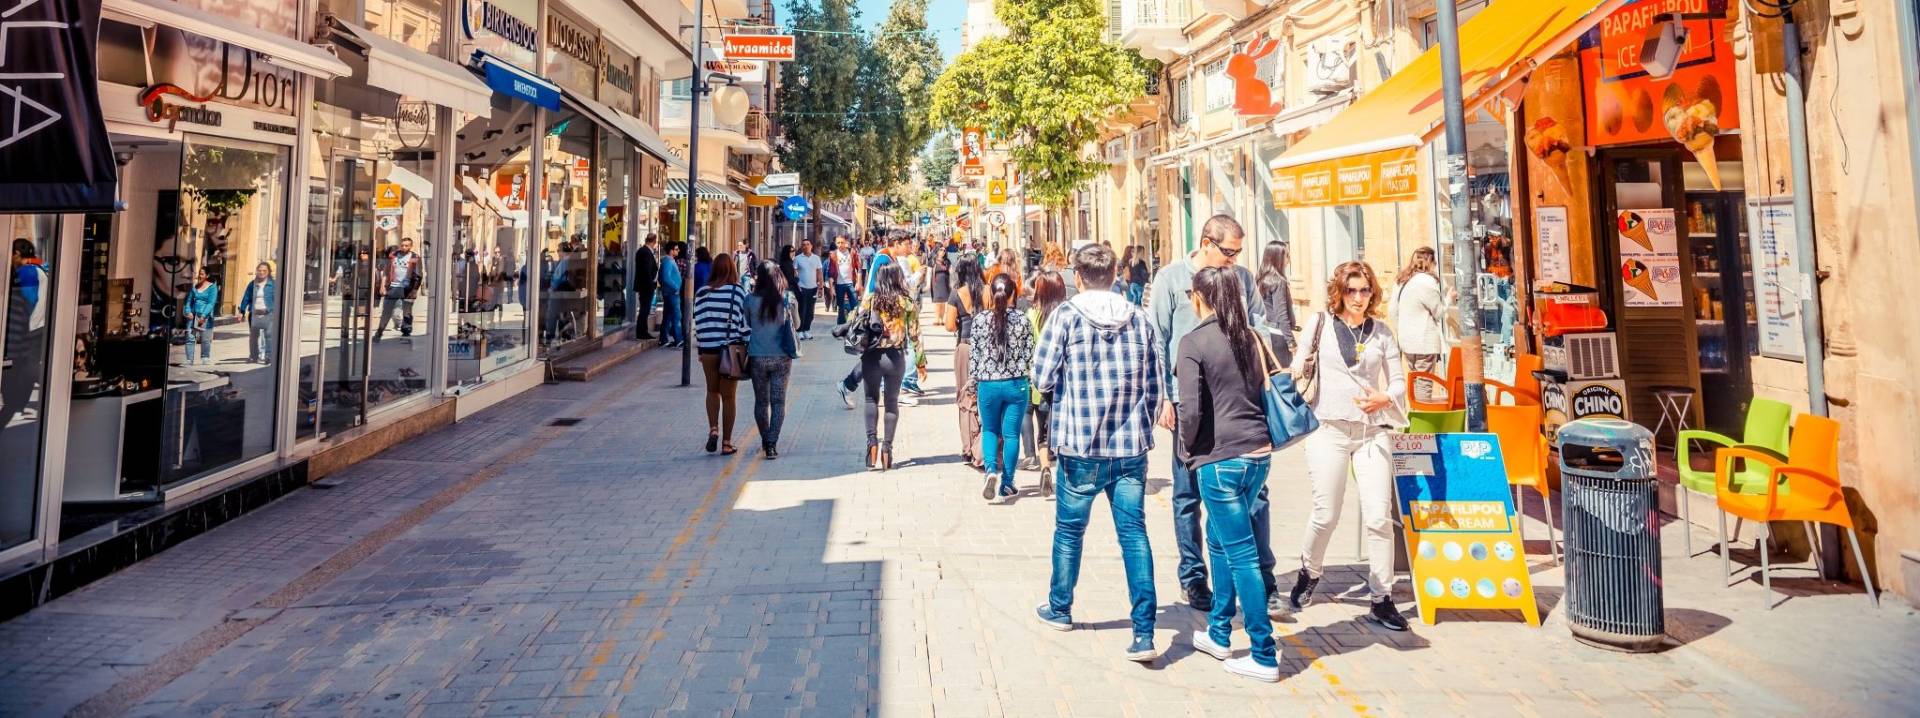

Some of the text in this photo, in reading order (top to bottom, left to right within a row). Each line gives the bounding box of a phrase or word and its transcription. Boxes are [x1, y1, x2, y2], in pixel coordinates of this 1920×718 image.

[725, 40, 793, 54] Avraamides
[1617, 45, 1638, 69] ICE
[0, 0, 69, 148] LIA
[219, 41, 291, 110] Dior
[965, 167, 983, 175] KFC
[1582, 386, 1610, 396] ORIGINAL
[1574, 395, 1622, 416] CHINO
